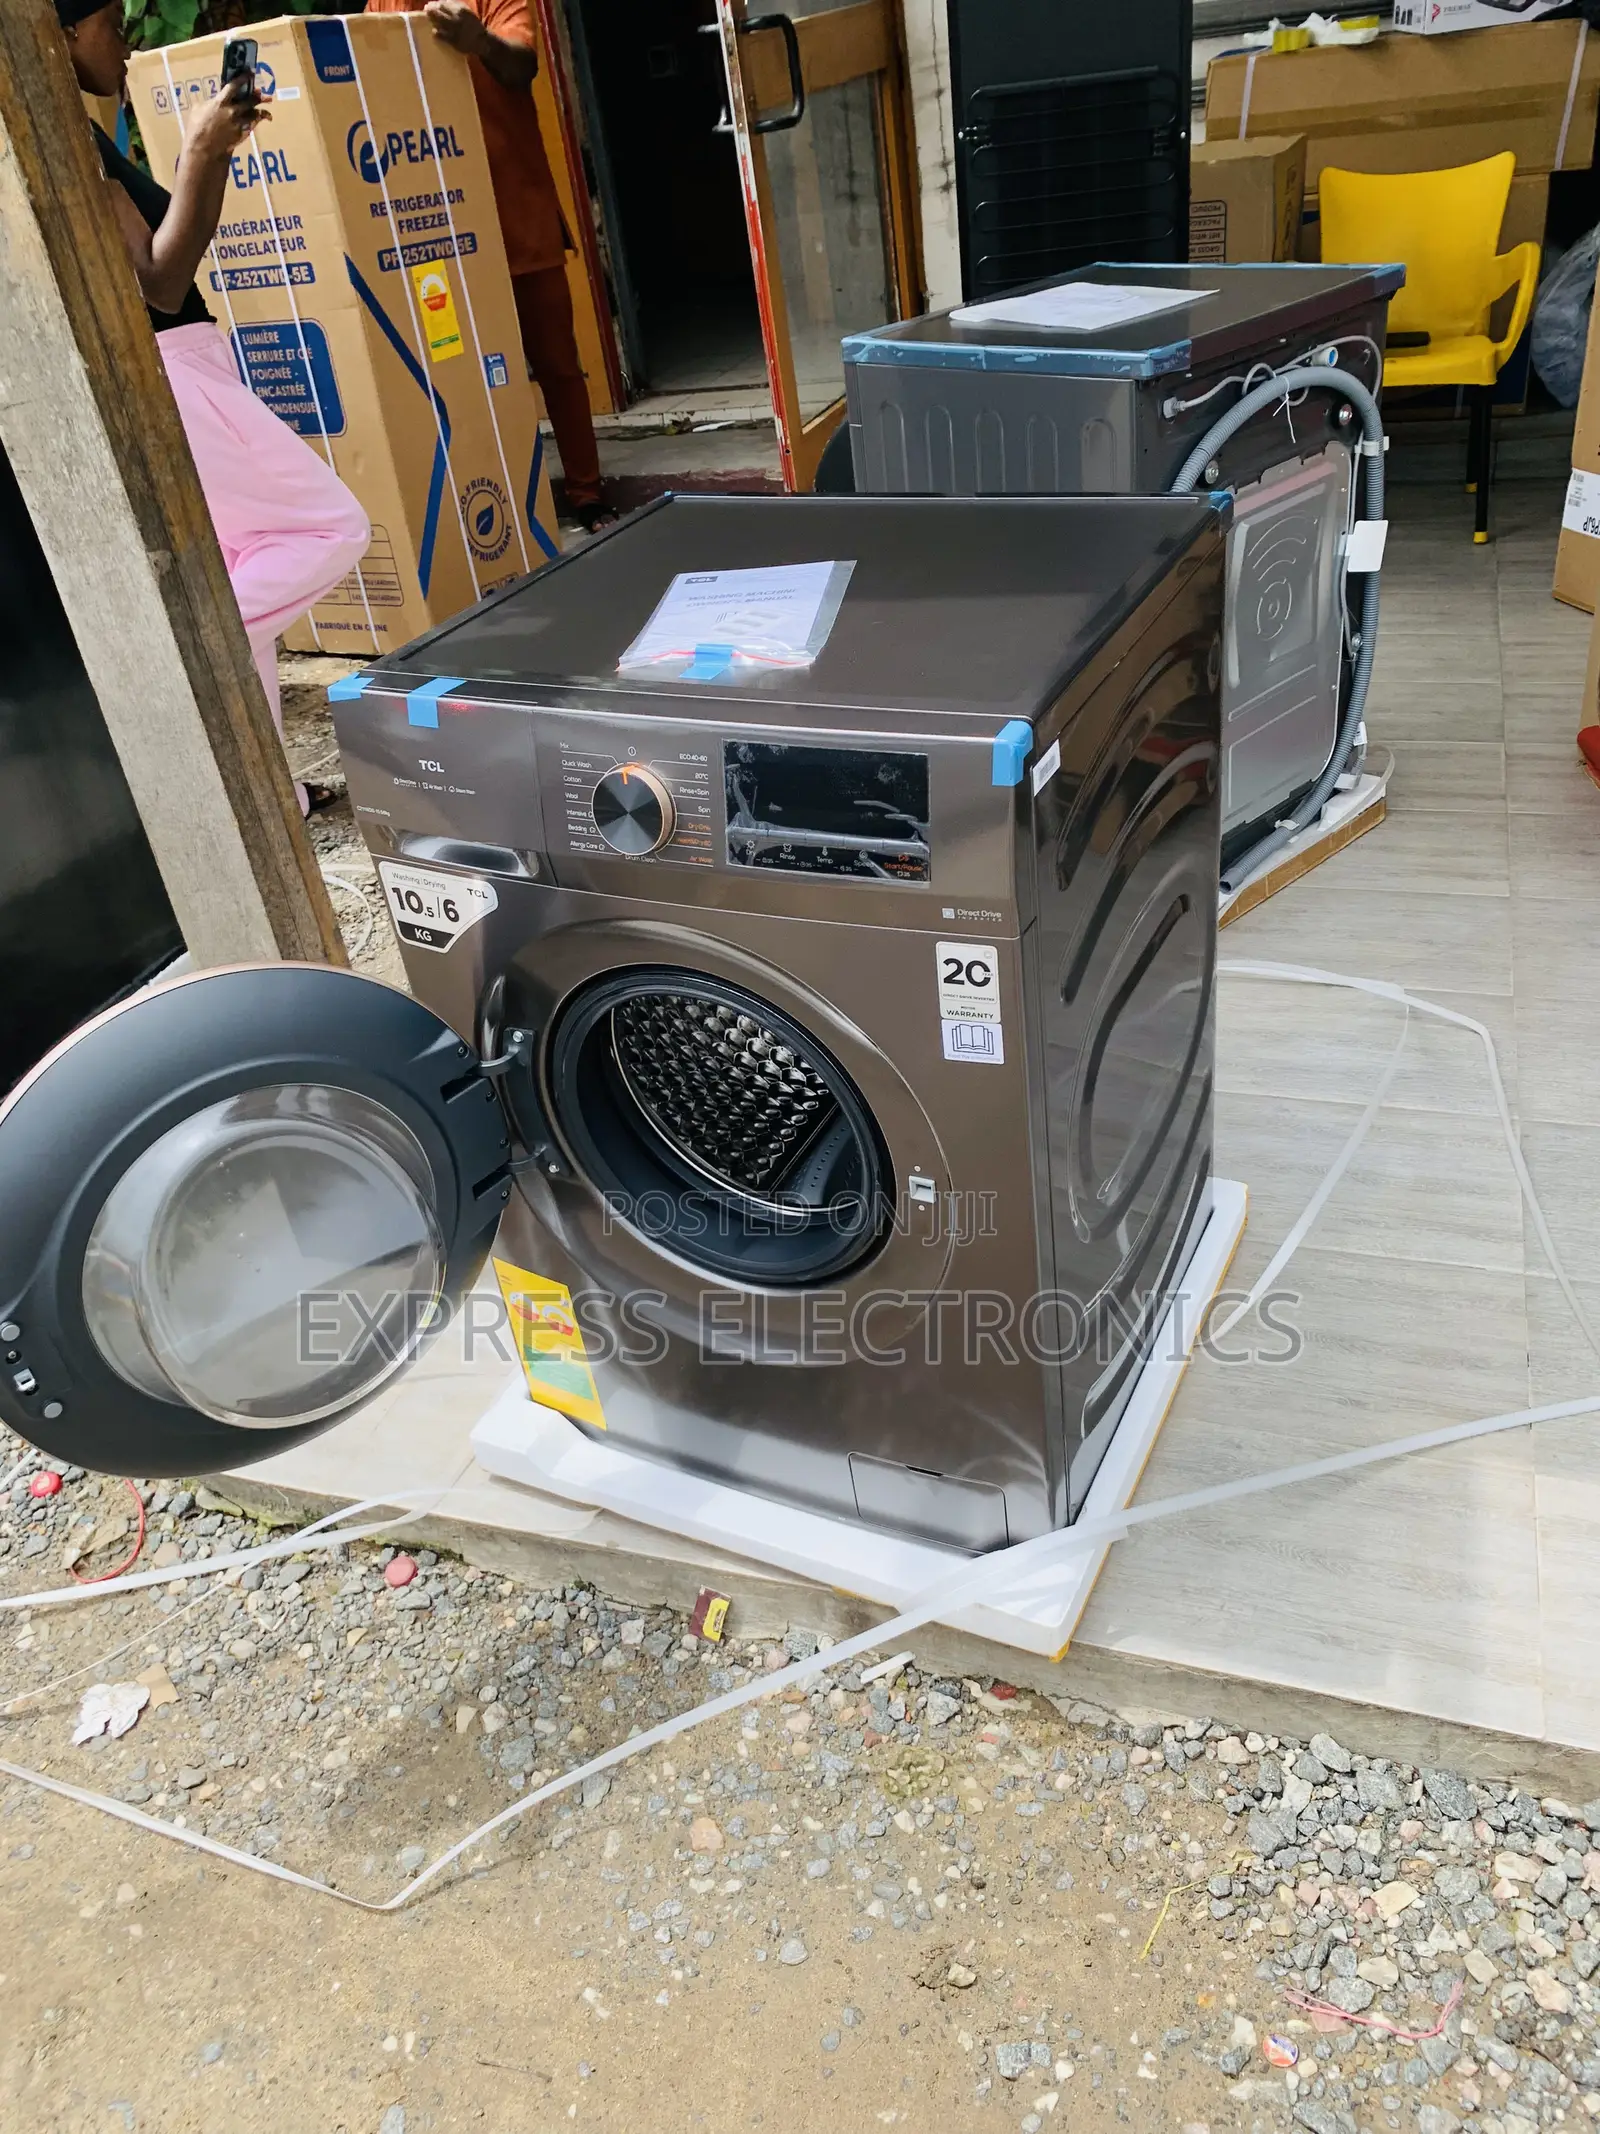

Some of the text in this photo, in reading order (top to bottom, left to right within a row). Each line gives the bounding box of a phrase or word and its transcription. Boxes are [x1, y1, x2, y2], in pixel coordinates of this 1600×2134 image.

[323, 65, 350, 76] FRONT
[387, 125, 465, 166] PEARL
[230, 148, 297, 189] EARL
[246, 349, 285, 363] SERRURE
[297, 344, 313, 360] CÉ
[365, 623, 388, 633] CINE
[419, 759, 445, 773] TCL
[563, 775, 582, 783] Cotton
[698, 805, 711, 814] Spin
[568, 823, 588, 834] Bedding
[780, 852, 796, 860] Rinse
[817, 856, 834, 865] Temp
[392, 872, 446, 890] Washing Drying
[467, 888, 488, 899] TCL
[957, 908, 1002, 918] Direct Drive
[414, 927, 432, 942] KG
[946, 1009, 994, 1020] WARRANTY
